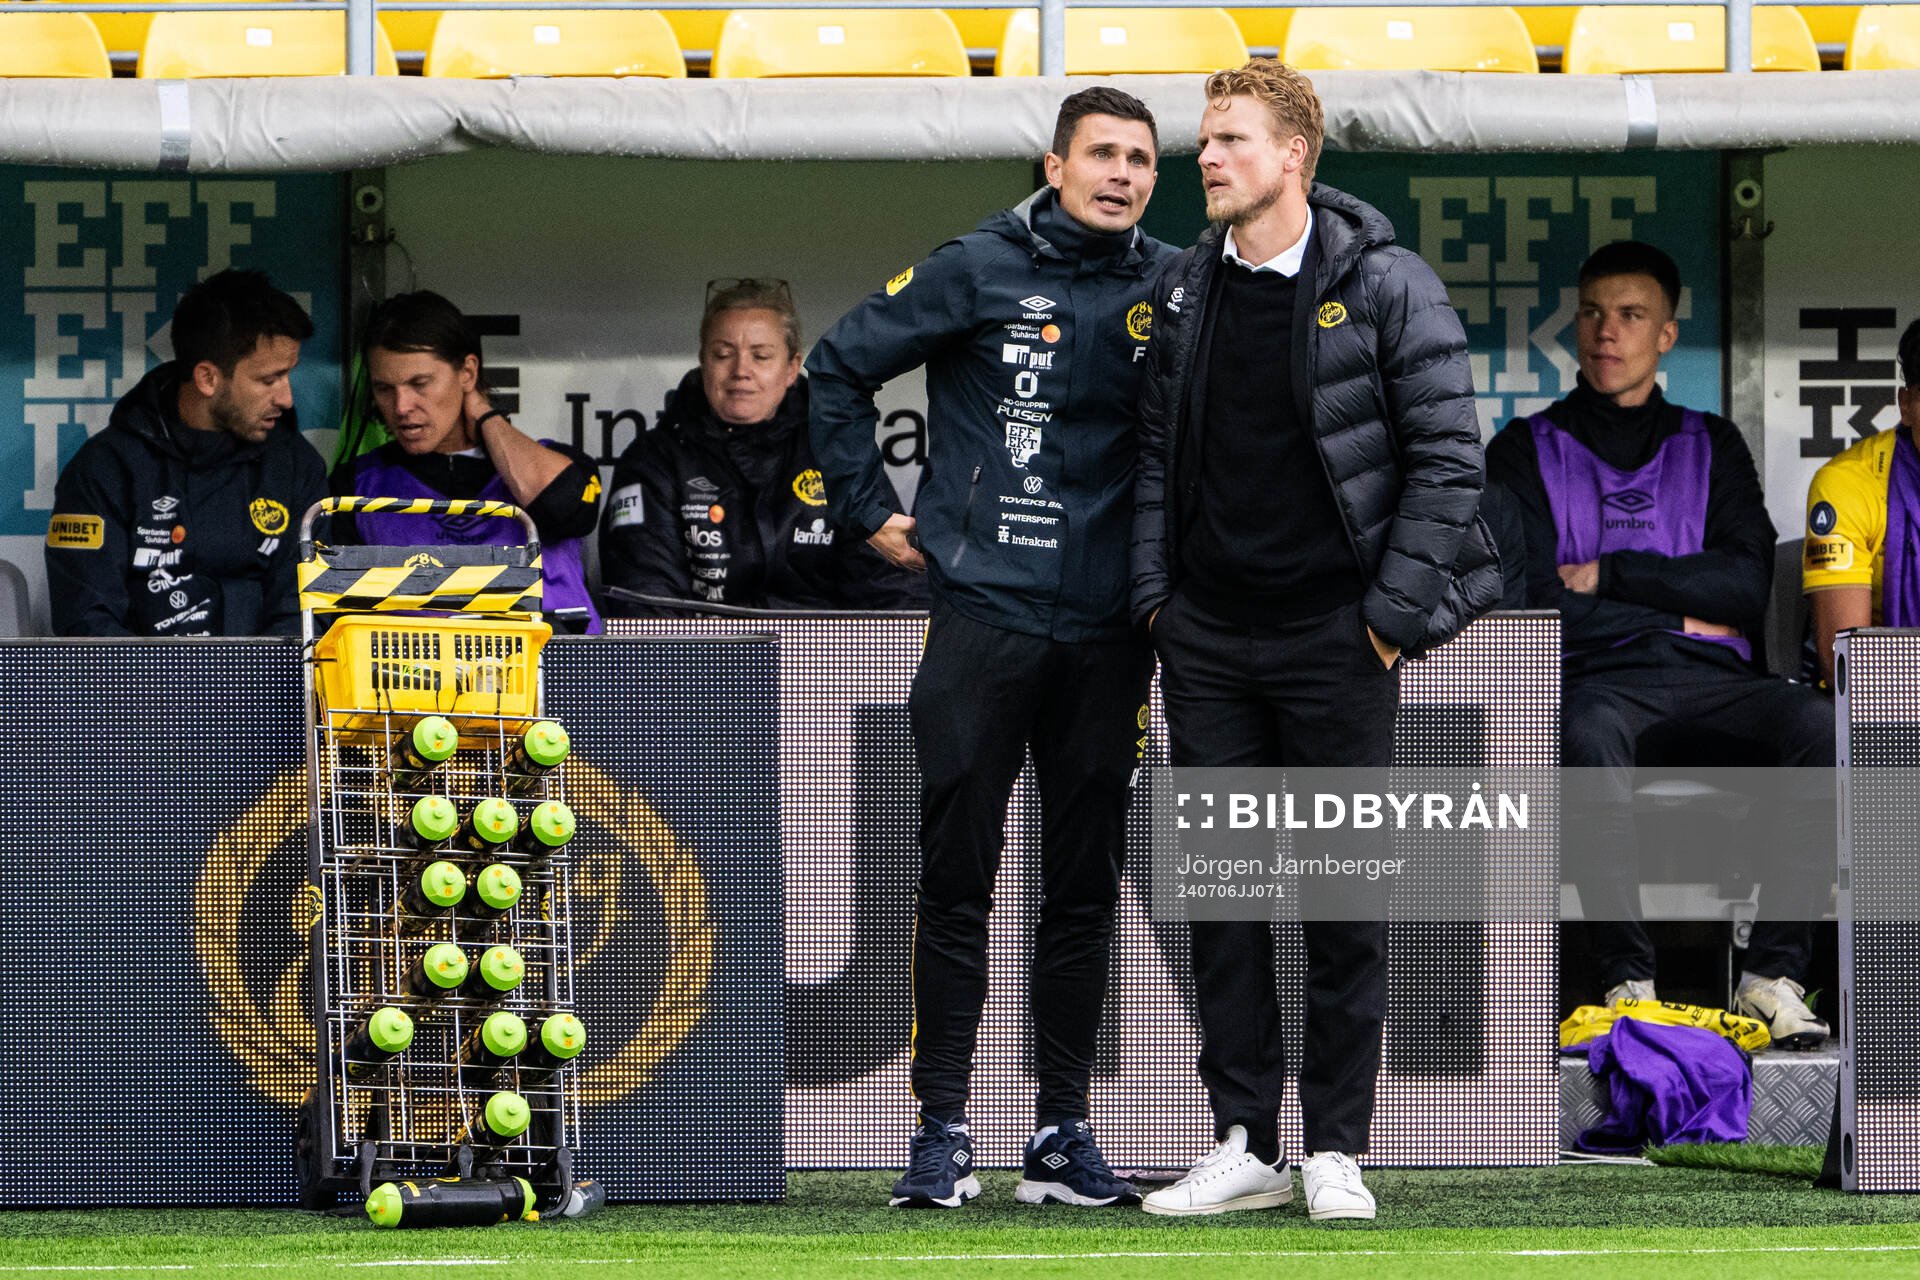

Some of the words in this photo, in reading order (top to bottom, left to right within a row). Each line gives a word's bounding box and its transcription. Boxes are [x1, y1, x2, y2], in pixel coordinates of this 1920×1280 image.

[1022, 311, 1053, 320] umbro
[996, 404, 1053, 423] PULSEN
[1009, 425, 1036, 439] EFF
[1008, 436, 1038, 450] EKT
[998, 495, 1047, 507] TOVEKS
[1008, 512, 1060, 526] INTERSPORT
[1605, 516, 1656, 530] umbro
[52, 522, 100, 534] UNIBET
[1011, 534, 1059, 549] Infrakraft
